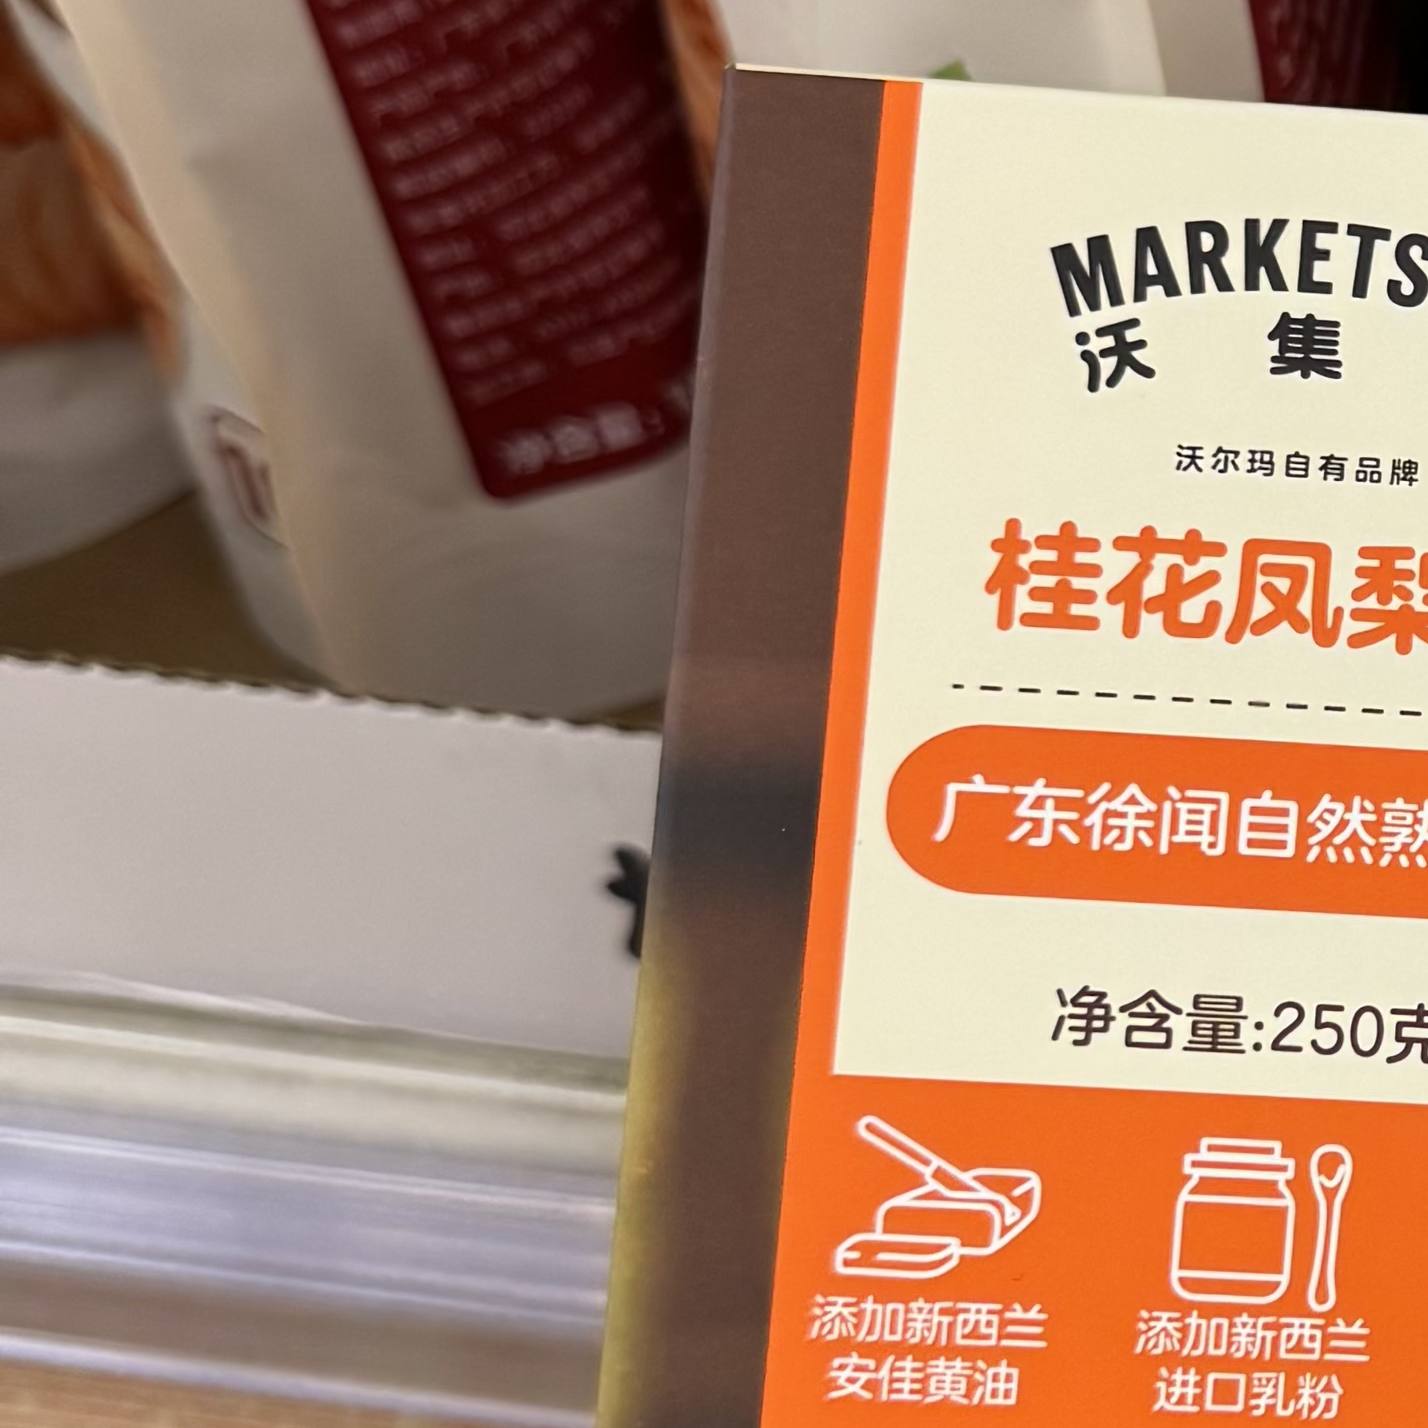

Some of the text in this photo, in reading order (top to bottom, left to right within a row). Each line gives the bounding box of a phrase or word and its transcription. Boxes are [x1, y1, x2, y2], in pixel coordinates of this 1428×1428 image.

[1174, 443, 1420, 488] 沃尔玛自有品牌
[808, 1293, 1049, 1350] 添加新西兰
[1133, 1307, 1371, 1364] 添加新西兰
[825, 1350, 1020, 1407] 安佳黄油
[1151, 1365, 1345, 1421] 进口乳粉
